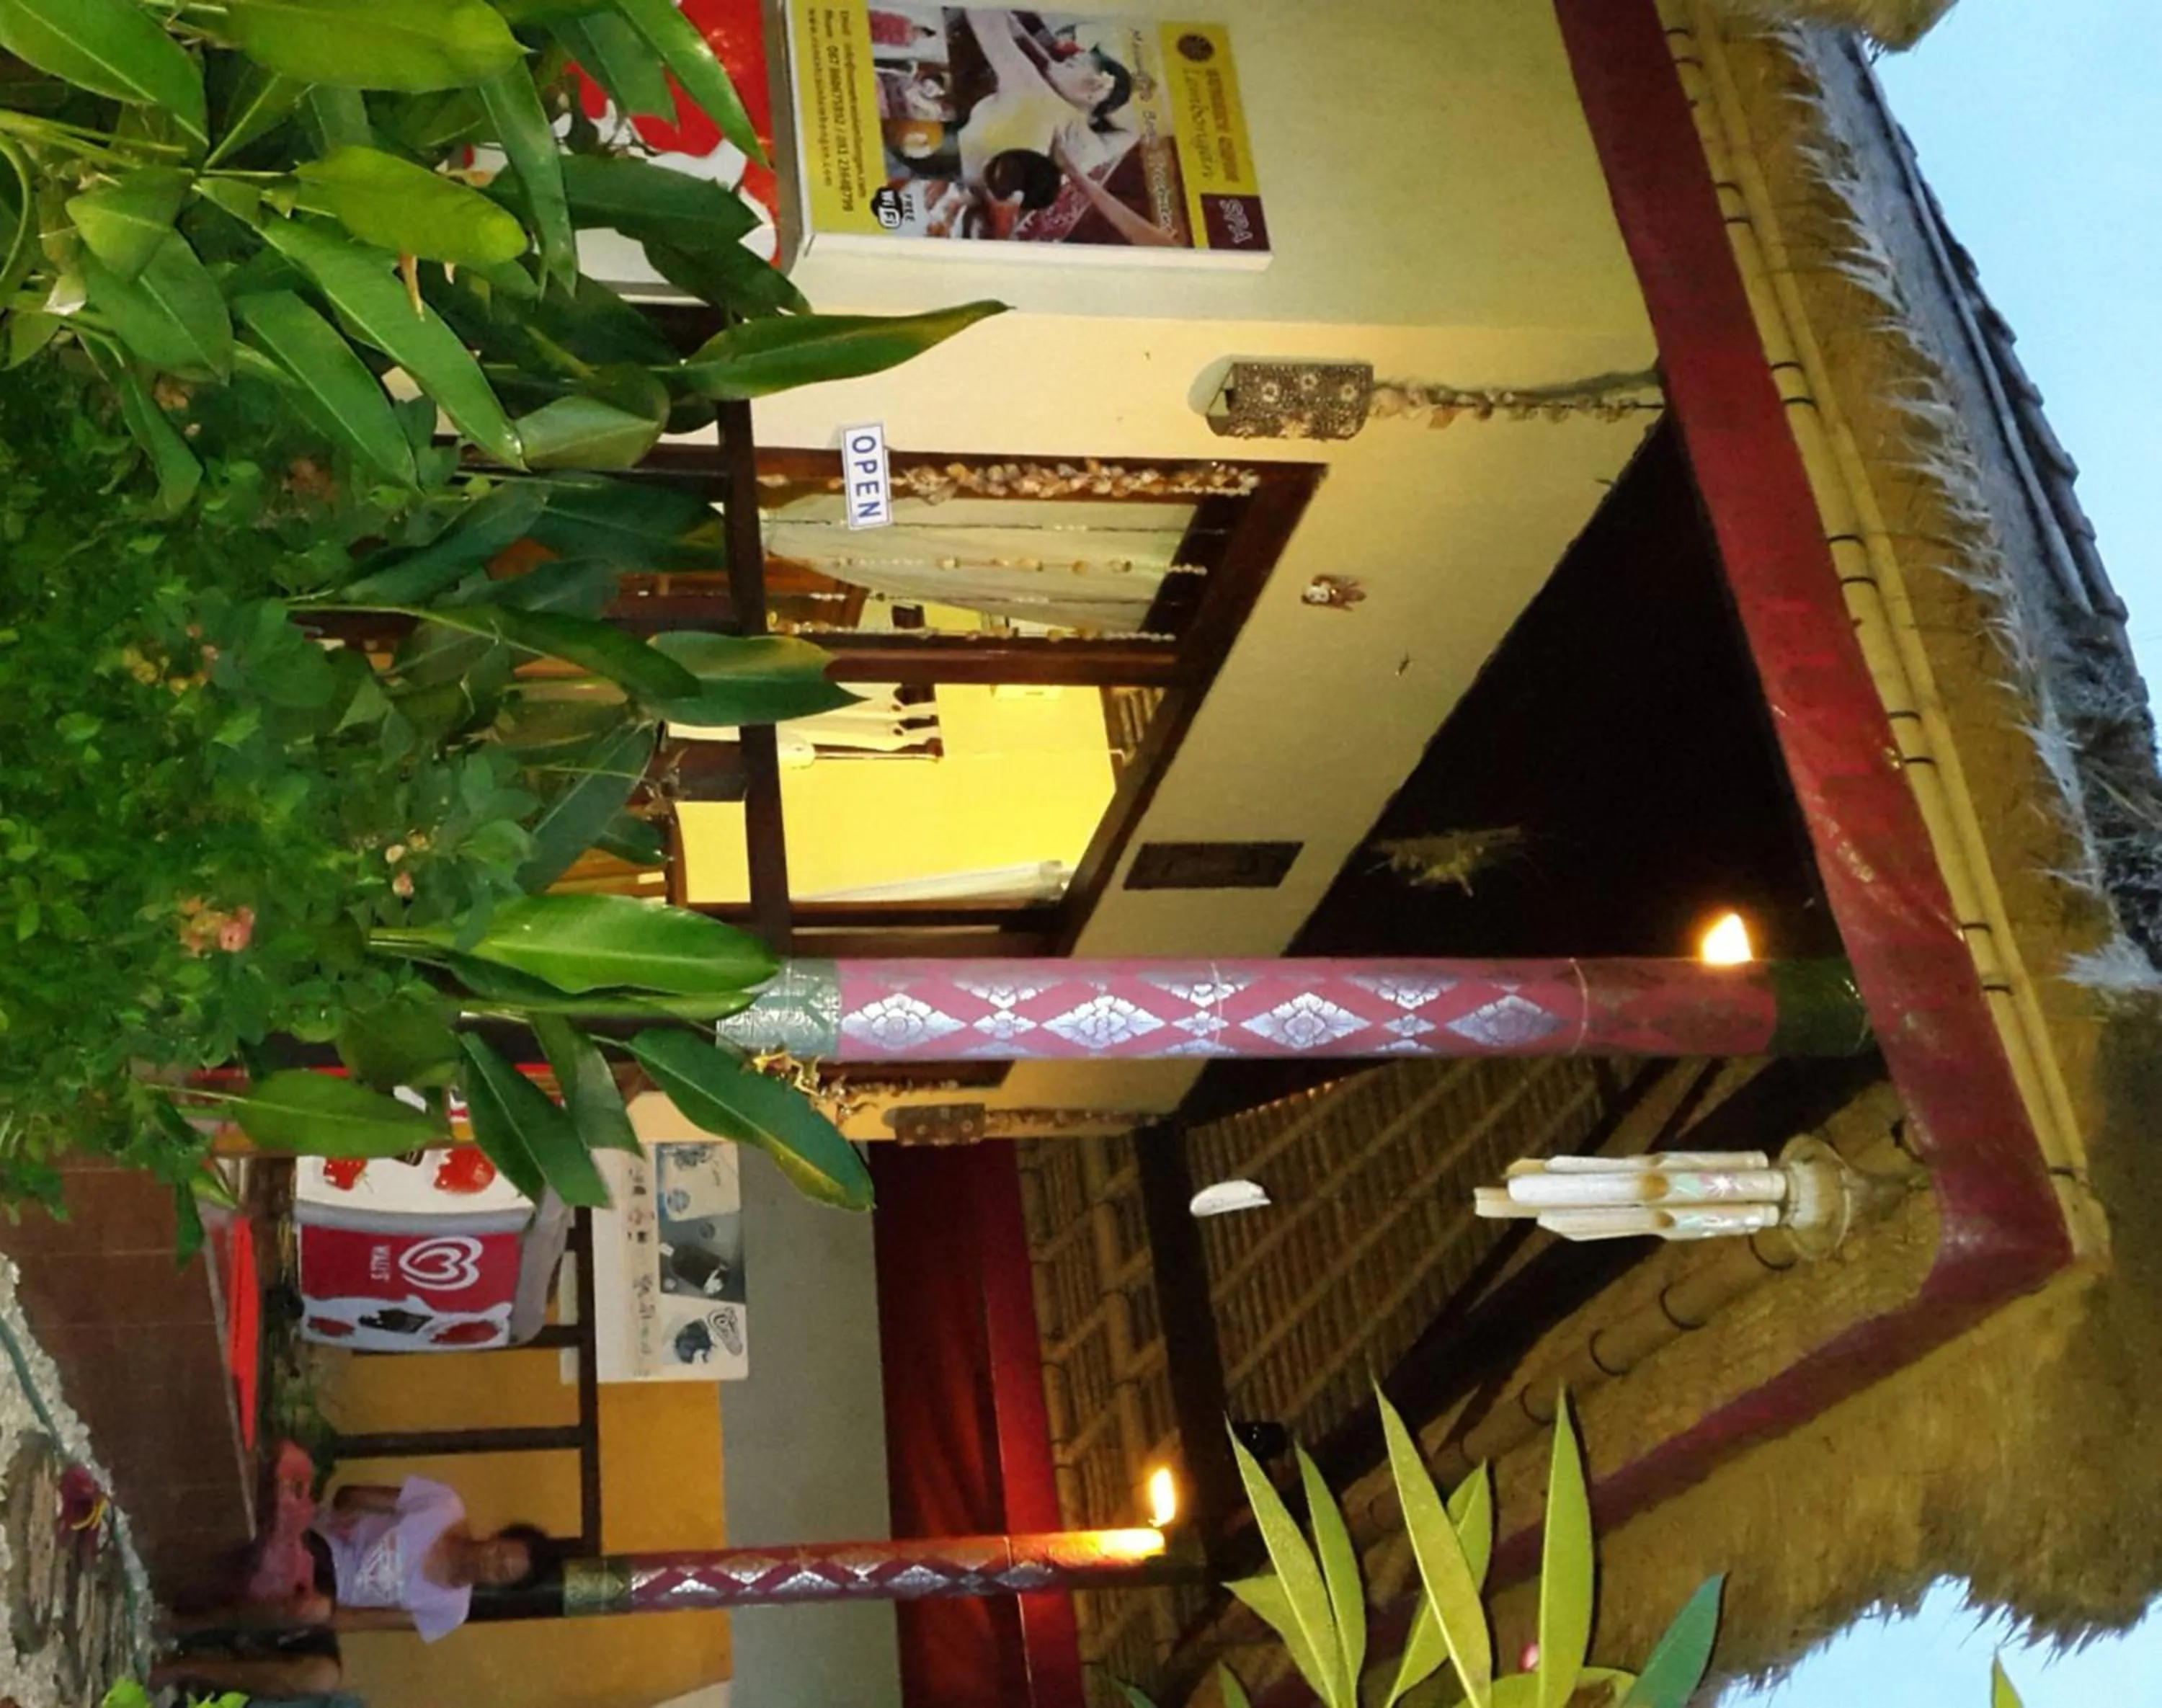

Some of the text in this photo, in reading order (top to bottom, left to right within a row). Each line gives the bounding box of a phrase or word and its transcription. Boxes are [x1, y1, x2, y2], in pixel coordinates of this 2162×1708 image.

[904, 193, 916, 222] FREE
[1219, 200, 1253, 244] SPA
[852, 435, 881, 518] OPEN
